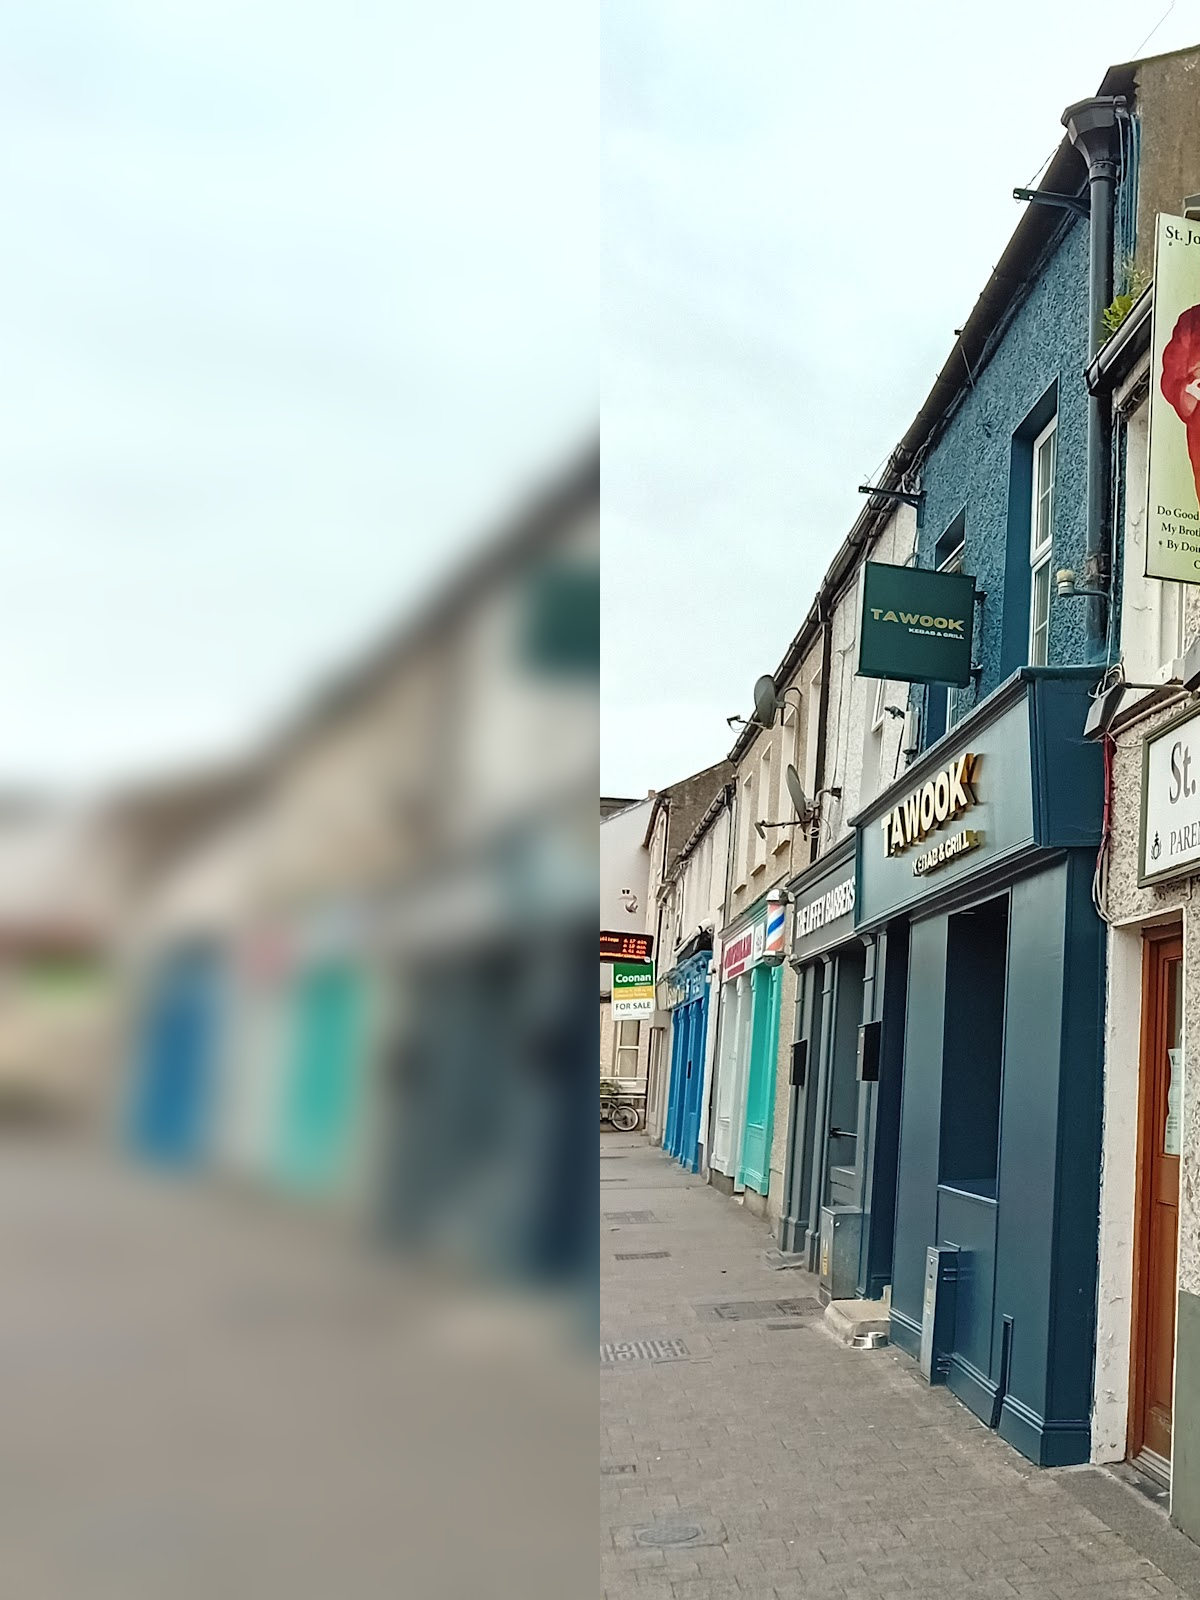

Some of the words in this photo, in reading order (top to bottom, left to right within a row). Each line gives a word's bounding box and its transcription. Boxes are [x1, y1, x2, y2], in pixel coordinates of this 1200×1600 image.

[1165, 225, 1183, 241] St.
[1157, 505, 1172, 516] Do
[1173, 508, 1199, 521] Good
[1161, 522, 1178, 535] My
[1167, 540, 1179, 551] By
[870, 608, 965, 632] TAWOOK
[908, 627, 936, 636] KEBAB
[943, 632, 965, 640] GRILL
[1169, 741, 1196, 804] St.
[881, 753, 970, 858] TAWOOK
[912, 847, 939, 876] KEBAB
[945, 829, 970, 858] GRILL
[615, 973, 652, 983] Coonan
[615, 1003, 630, 1011] FOR
[633, 1001, 651, 1010] SALE
